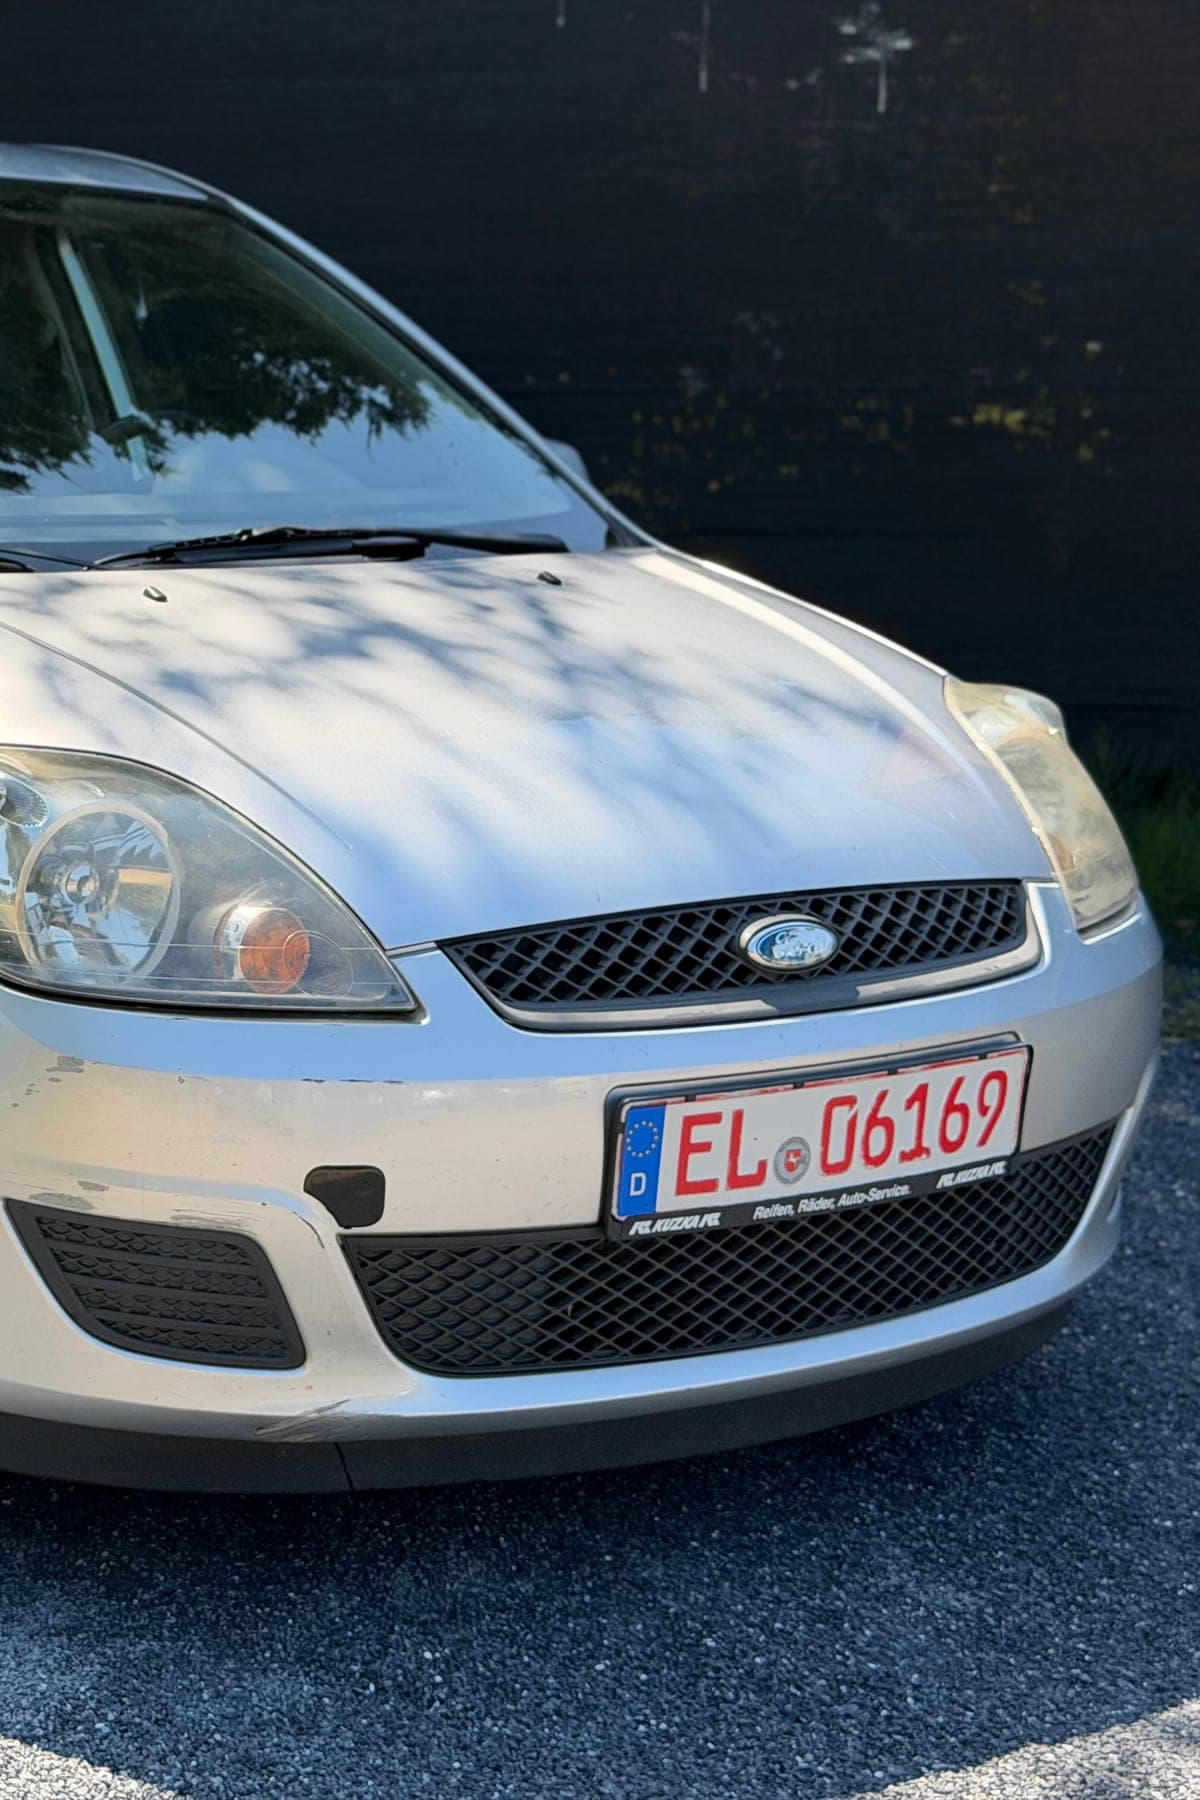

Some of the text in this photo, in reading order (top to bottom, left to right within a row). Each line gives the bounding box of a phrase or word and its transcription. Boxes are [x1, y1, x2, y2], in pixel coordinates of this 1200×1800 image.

[674, 1069, 1009, 1196] EL 06169
[629, 1172, 646, 1197] D
[752, 1203, 795, 1220] Reifen,
[797, 1198, 836, 1213] Räder,
